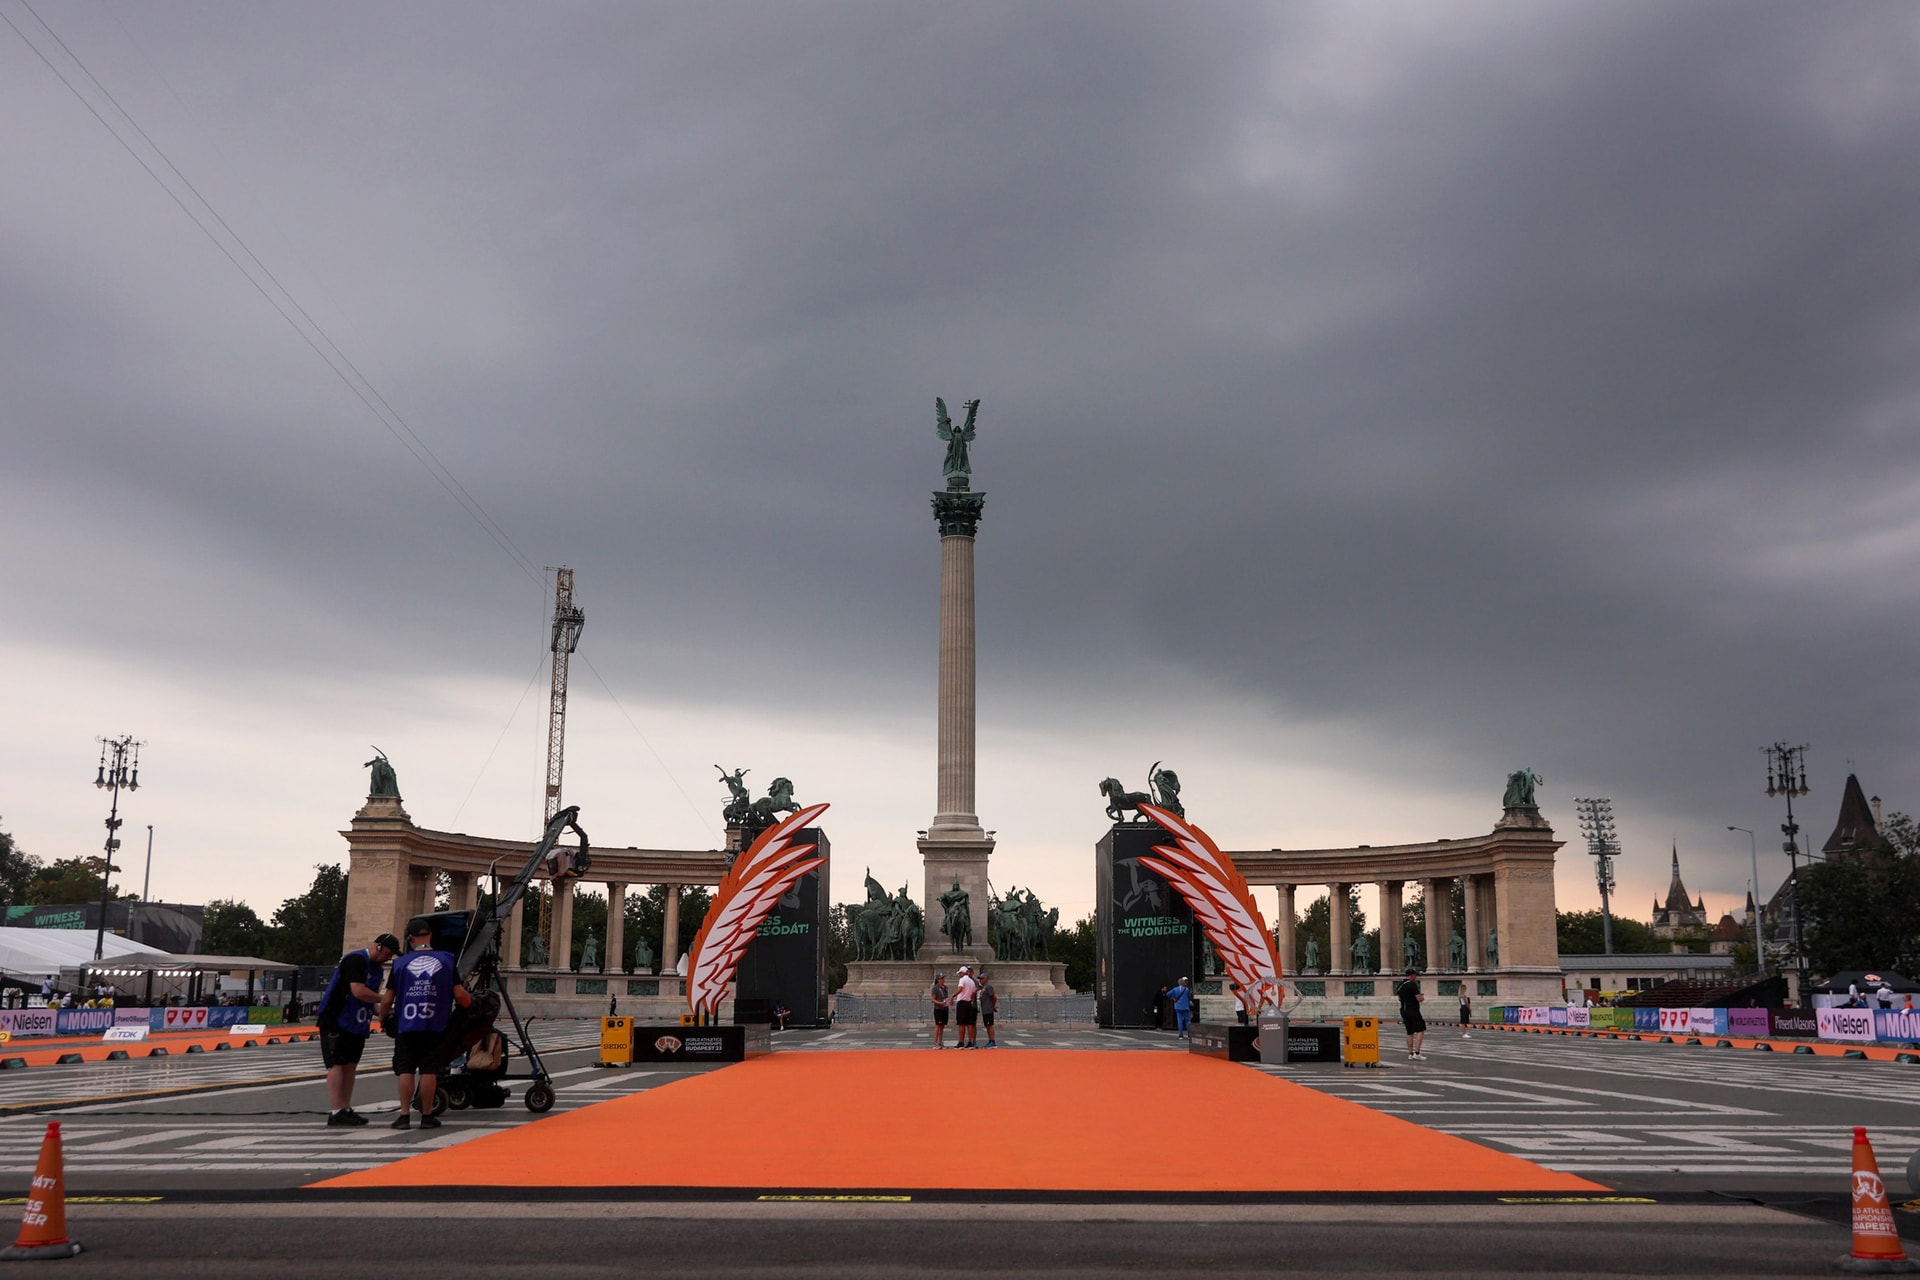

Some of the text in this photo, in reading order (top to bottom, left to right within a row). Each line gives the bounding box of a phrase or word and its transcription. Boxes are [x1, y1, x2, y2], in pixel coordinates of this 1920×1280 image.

[35, 911, 81, 926] WITNESS
[1124, 916, 1180, 928] WITNESS
[1131, 924, 1188, 937] WONDER
[12, 1014, 52, 1031] Nielsen
[67, 1011, 112, 1030] MONDO
[1775, 1016, 1816, 1031] Pinsent Masons
[1832, 1014, 1870, 1034] Nielsen
